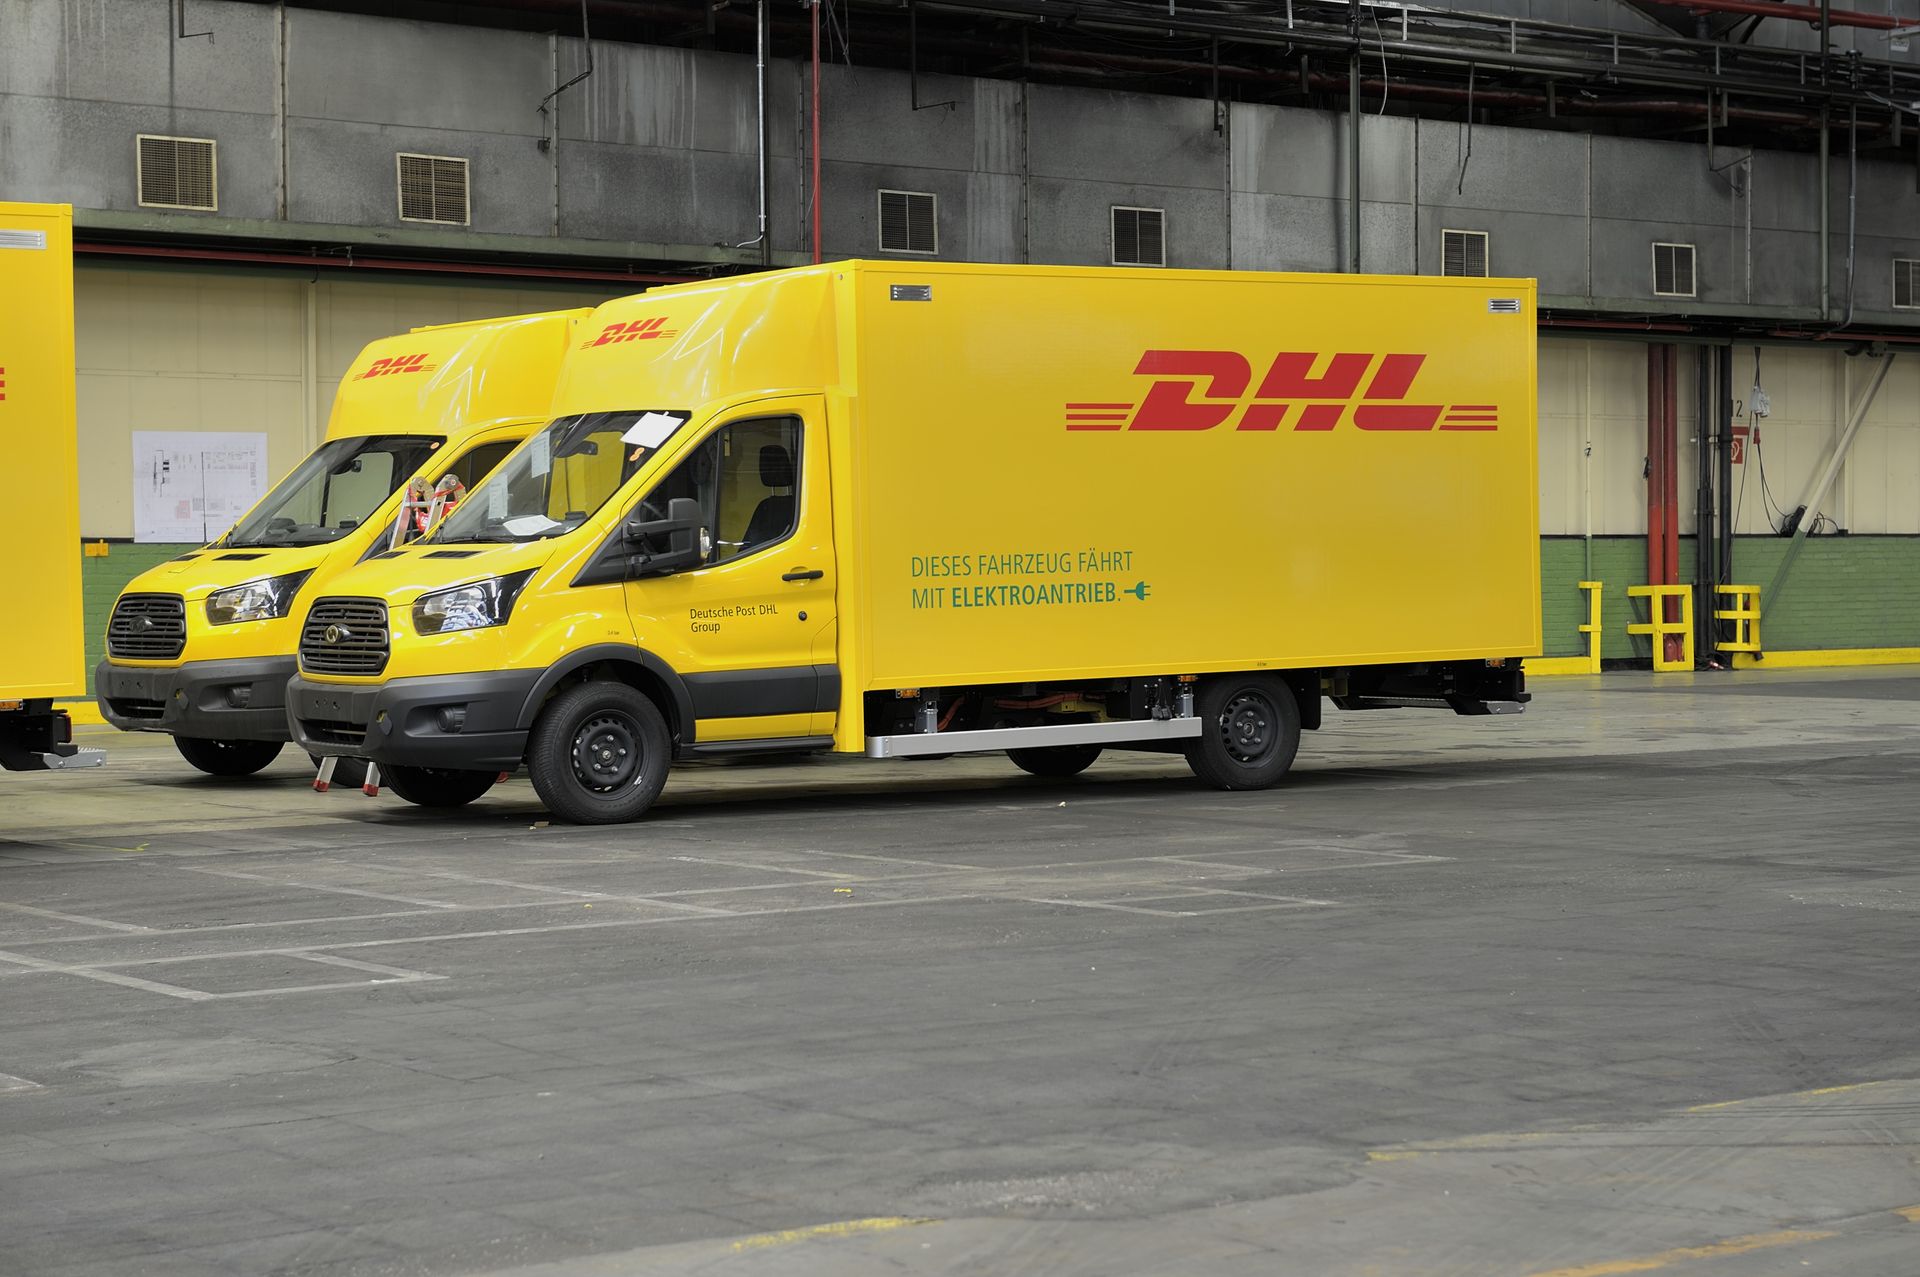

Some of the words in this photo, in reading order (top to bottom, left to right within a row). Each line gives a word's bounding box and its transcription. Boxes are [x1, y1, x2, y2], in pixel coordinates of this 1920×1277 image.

[591, 317, 669, 347] DHL
[363, 353, 429, 379] DHL
[1127, 350, 1445, 431] DHL
[911, 556, 972, 577] DIESES
[978, 552, 1071, 575] FAHRZEUG
[1078, 547, 1133, 573] FÄHRT
[912, 587, 945, 609] MIT
[952, 582, 1121, 608] ELEKTROANTRIEB.
[690, 607, 733, 619] Deutsche
[736, 605, 755, 617] Post
[760, 604, 778, 615] DHL
[691, 621, 721, 634] Group
